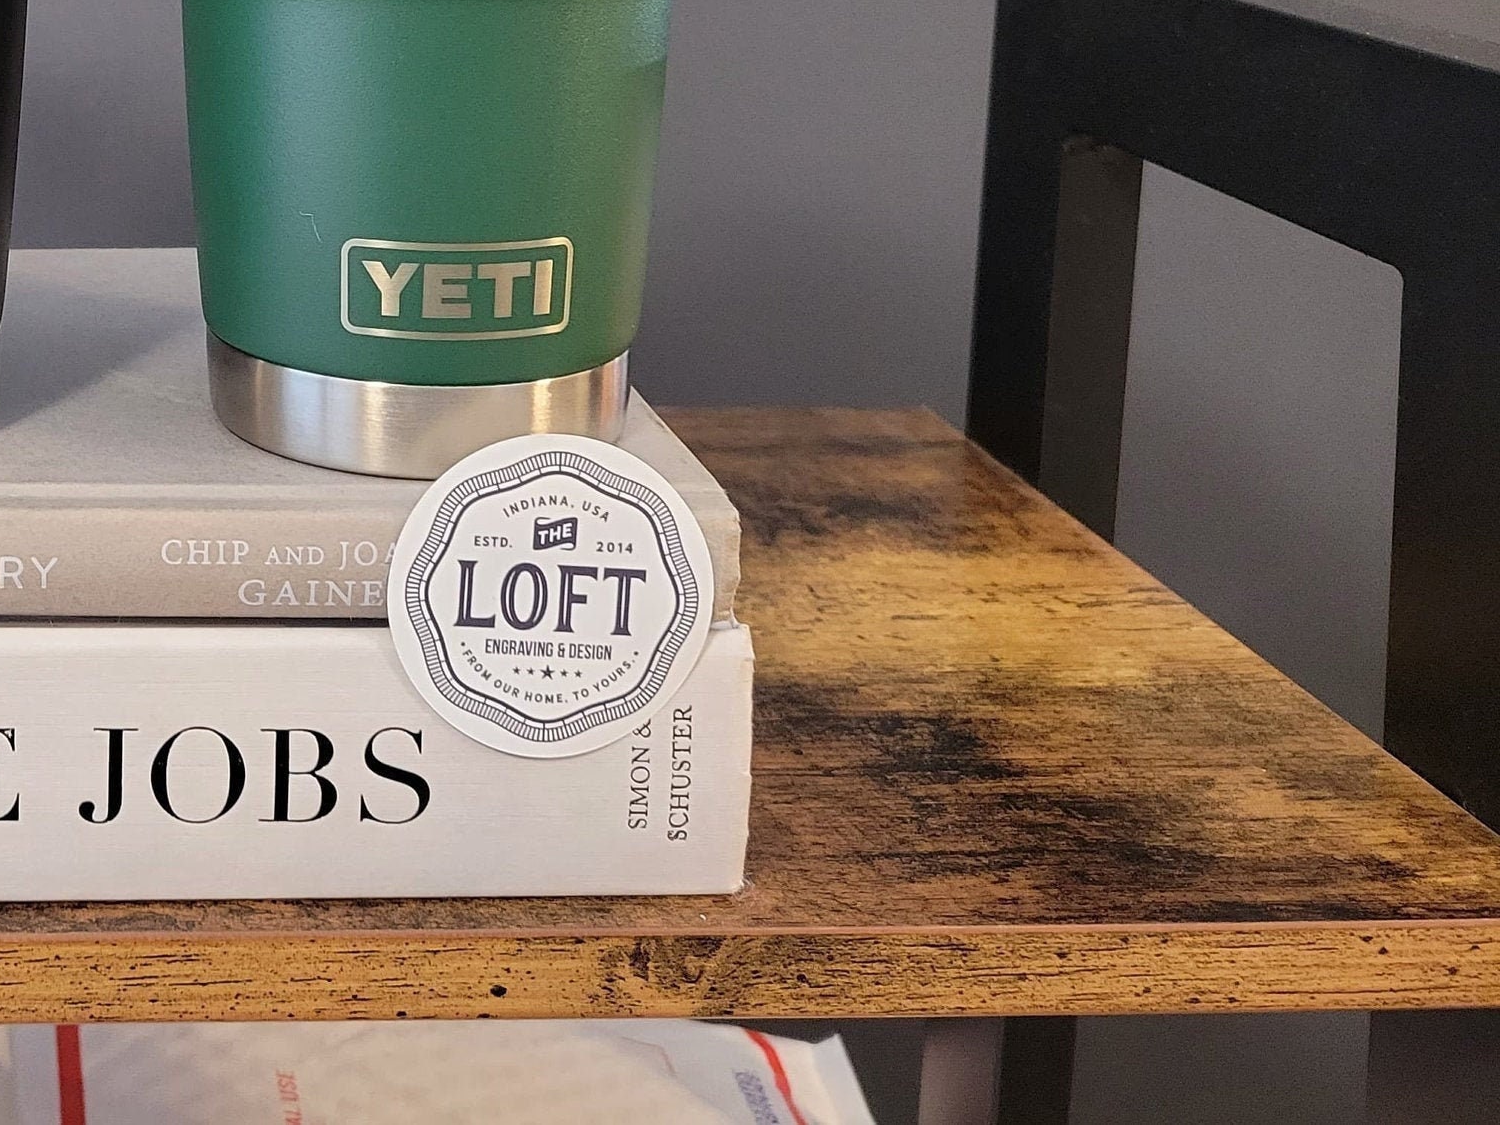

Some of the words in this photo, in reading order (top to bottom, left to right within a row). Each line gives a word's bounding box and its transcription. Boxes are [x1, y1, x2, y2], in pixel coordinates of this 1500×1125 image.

[361, 259, 554, 319] YETI
[581, 500, 610, 523] USA
[474, 535, 513, 549] ESTD.
[537, 522, 573, 545] THE
[596, 541, 633, 554] 2014
[161, 539, 249, 565] CHIP
[264, 546, 325, 566] AND
[338, 541, 395, 571] JOA
[238, 579, 385, 607] GAINE
[453, 559, 647, 637] LOFT
[484, 638, 555, 658] ENGRAVING
[557, 642, 566, 658] &
[568, 644, 613, 661] DESIGN
[462, 649, 493, 682] FROM
[493, 679, 521, 699] OUR
[572, 688, 590, 701] TO
[632, 718, 651, 739] &
[78, 725, 432, 825] JOBS
[627, 746, 651, 829] SIMON
[667, 705, 693, 841] SCHUSTER
